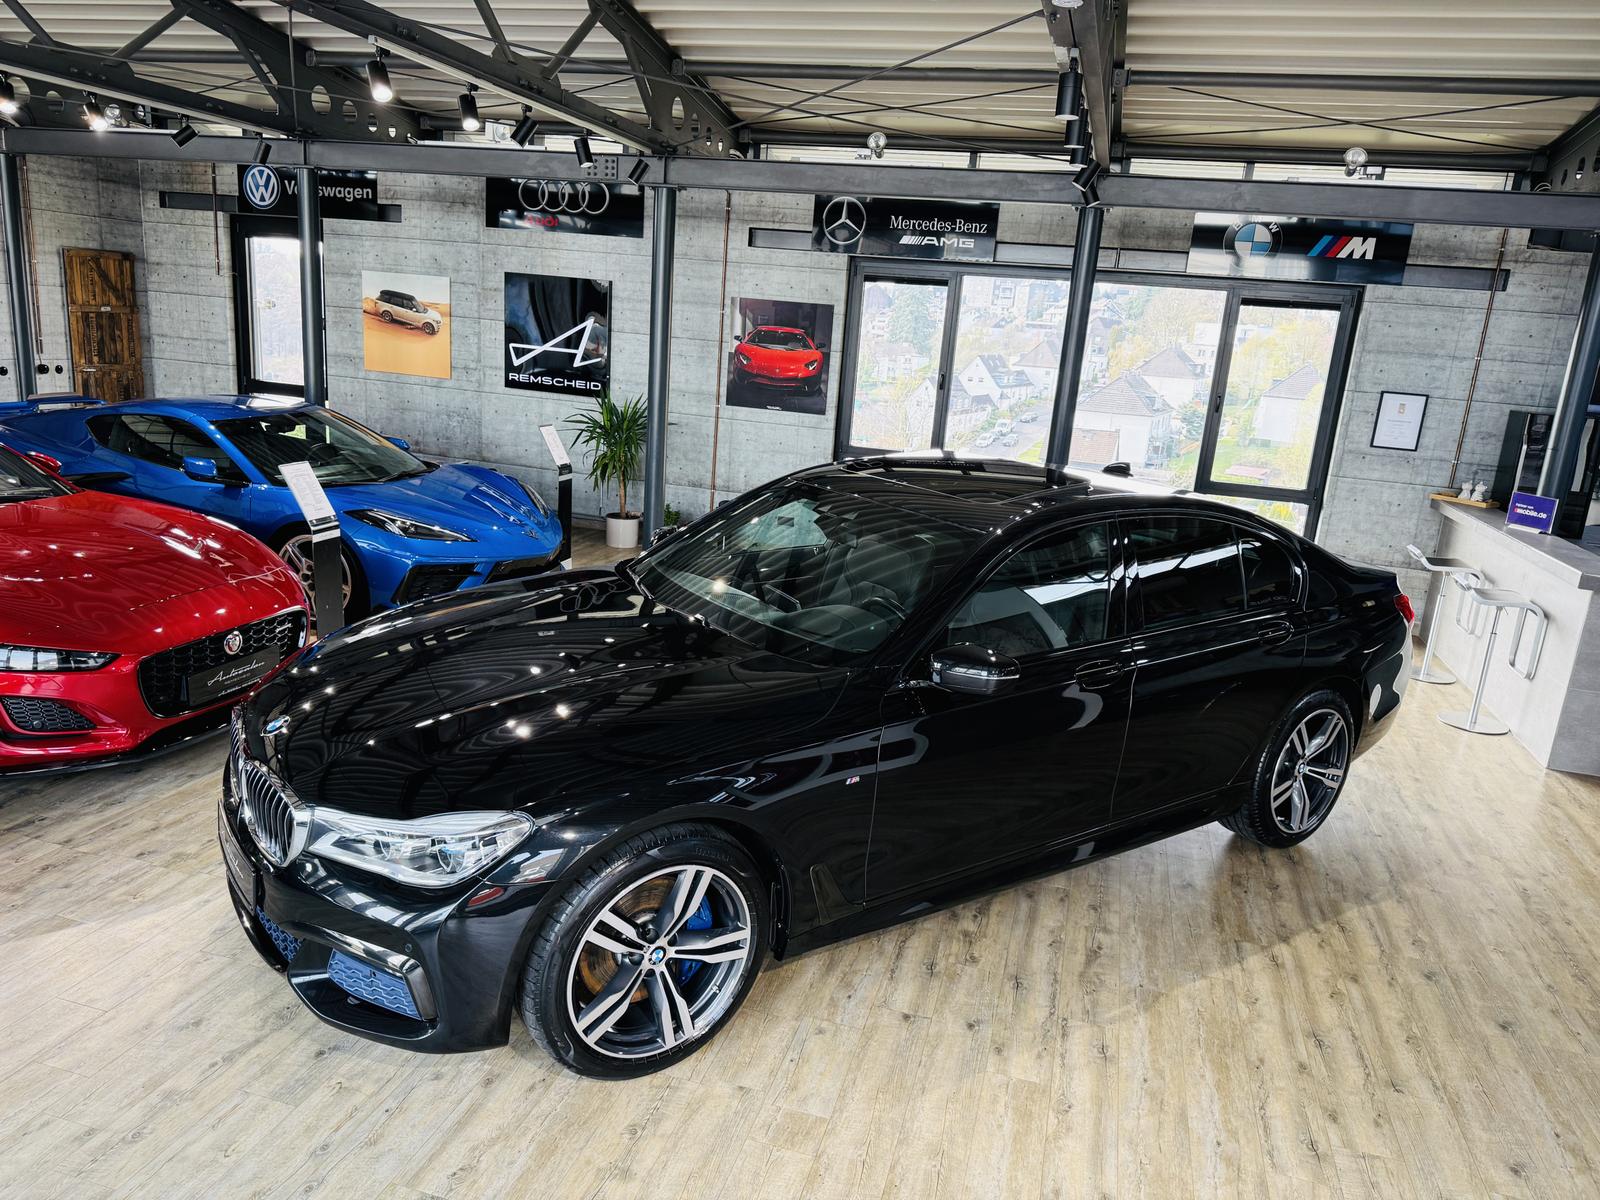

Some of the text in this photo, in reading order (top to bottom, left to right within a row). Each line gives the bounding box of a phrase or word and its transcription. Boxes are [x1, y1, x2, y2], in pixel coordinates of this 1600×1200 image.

[284, 180, 372, 202] Vswagen
[889, 215, 988, 234] Mercedes-Benz
[508, 372, 602, 391] REMSCHEID
[1516, 507, 1547, 518] mobile.de
